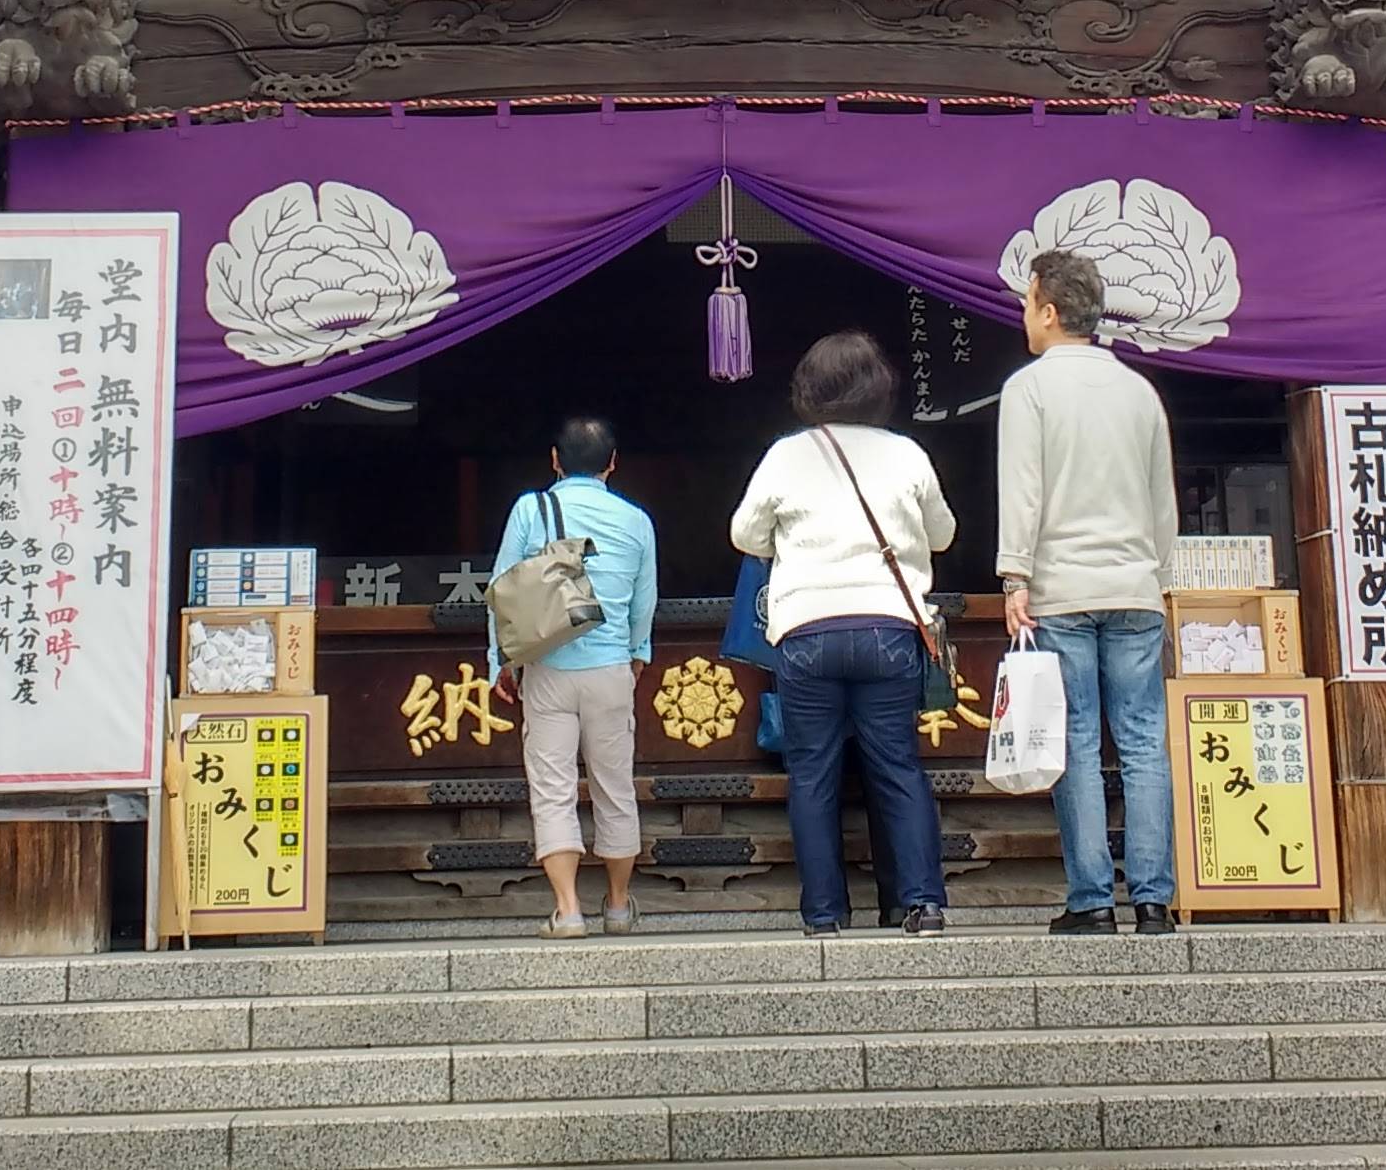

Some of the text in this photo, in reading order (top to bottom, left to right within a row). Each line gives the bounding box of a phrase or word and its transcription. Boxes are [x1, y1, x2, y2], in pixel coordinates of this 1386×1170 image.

[12, 536, 43, 705] 各四十五分程度
[1273, 608, 1288, 663] おみくじ
[286, 624, 302, 680] おみくじ
[190, 721, 242, 740] 天然石
[1199, 703, 1239, 720] 開運
[192, 752, 293, 898] おみくじ
[1199, 731, 1304, 875] おみくじ
[1200, 785, 1214, 878] 8種類のお守り入り
[216, 889, 250, 901] 200円
[1224, 865, 1258, 877] 200円
